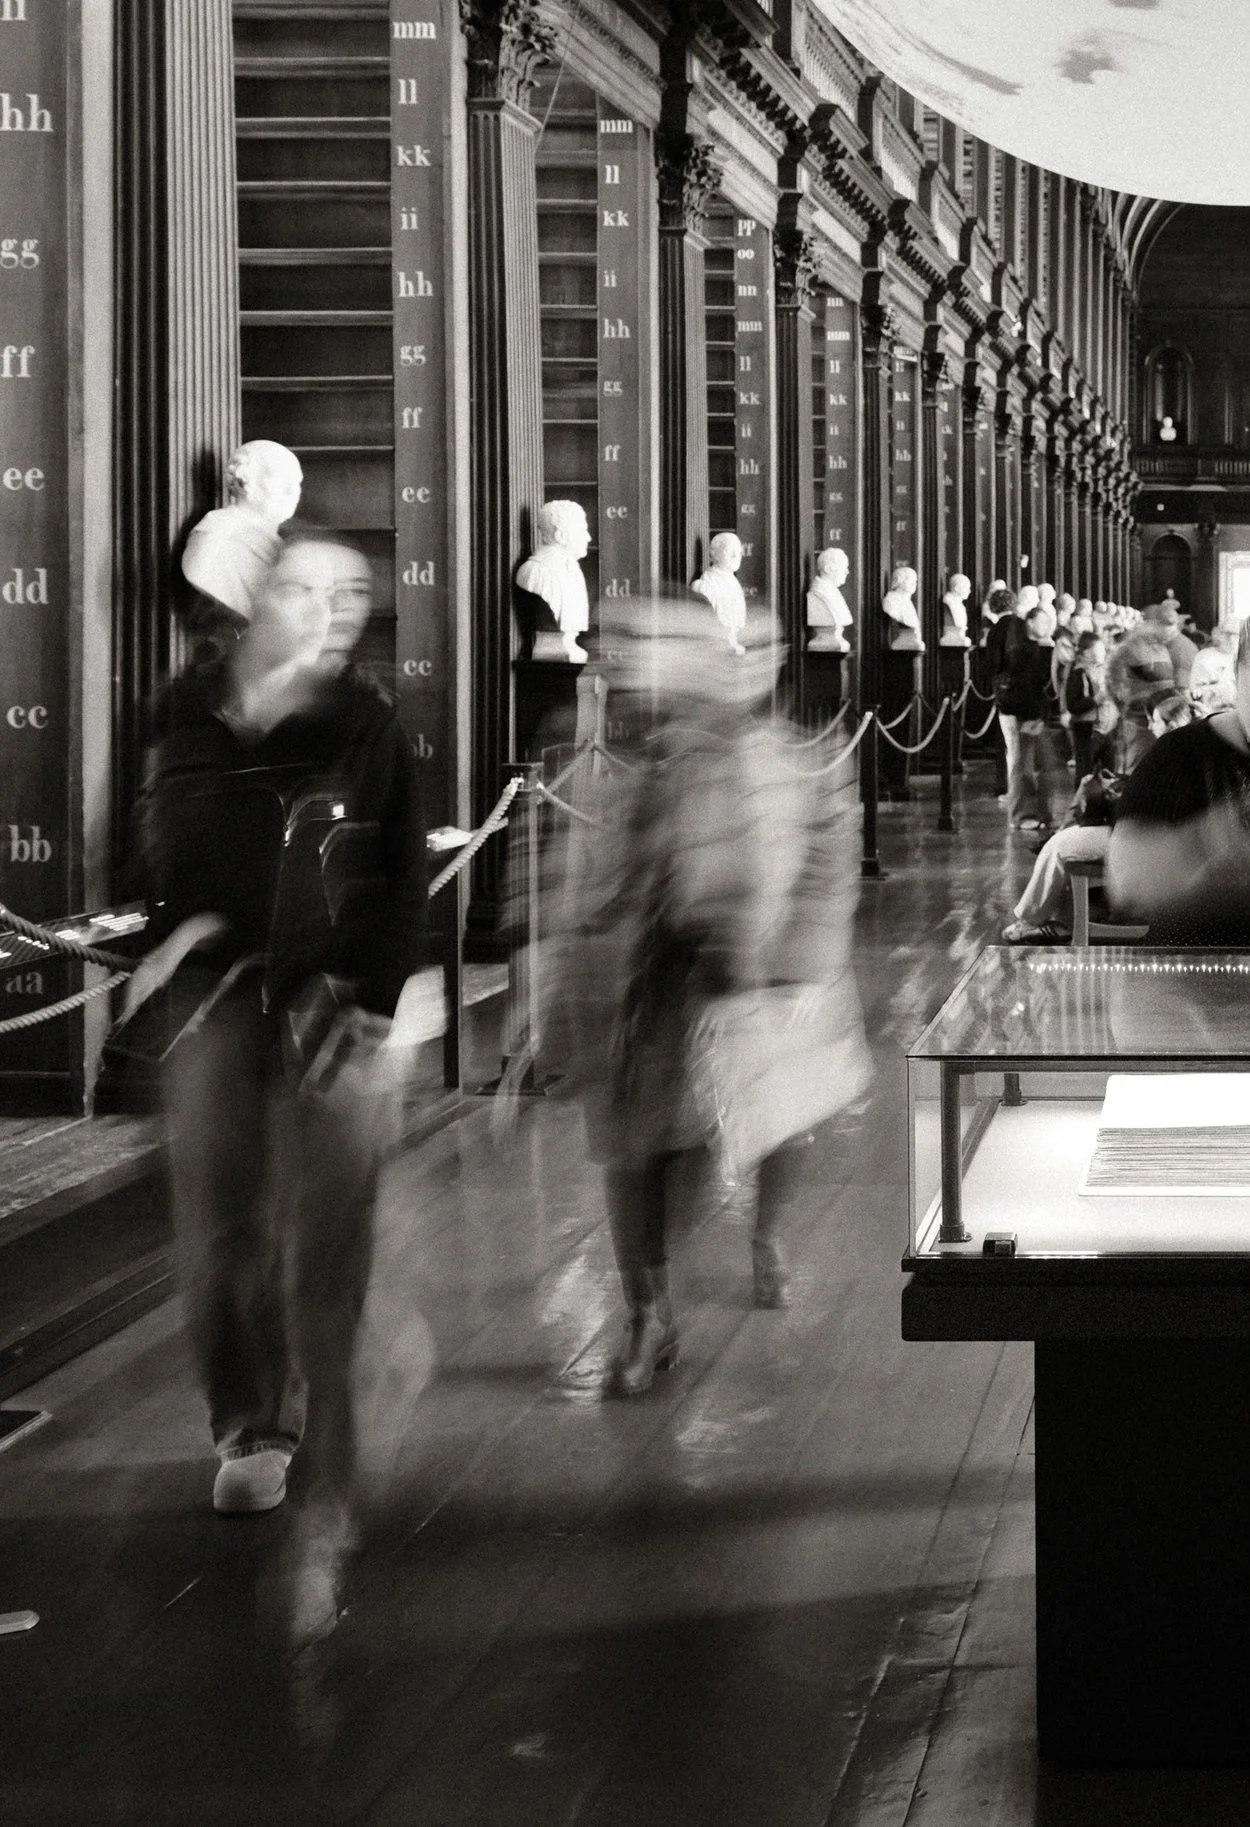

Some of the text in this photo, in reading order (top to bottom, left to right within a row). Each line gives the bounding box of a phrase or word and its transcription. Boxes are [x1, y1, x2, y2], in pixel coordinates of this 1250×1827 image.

[394, 22, 436, 39] mm
[399, 79, 417, 104] ll
[0, 93, 52, 131] hh
[600, 120, 632, 133] mm
[397, 145, 430, 165] kk
[606, 165, 619, 184] ll
[401, 208, 417, 229] ii
[604, 211, 628, 226] kk
[738, 220, 756, 236] pp
[0, 239, 39, 268] gg
[737, 249, 754, 259] oo
[398, 271, 432, 297] hh
[605, 271, 616, 287] ii
[738, 285, 756, 296] nn
[604, 318, 630, 338] hh
[738, 321, 762, 331] mm
[0, 346, 34, 378] ff
[400, 346, 425, 365] gg
[740, 356, 751, 371] ll
[604, 381, 622, 394] gg
[740, 392, 759, 404] kk
[830, 394, 846, 405] kk
[402, 407, 422, 428] ff
[605, 445, 620, 461] ff
[740, 459, 759, 474] hh
[829, 455, 846, 469] hh
[3, 468, 43, 490] ee
[402, 487, 429, 502] ee
[606, 507, 626, 519] ee
[403, 562, 433, 585] dd
[2, 568, 49, 604] dd
[606, 579, 632, 597] dd
[403, 660, 431, 675] cc
[7, 706, 49, 728] cc
[9, 825, 51, 861] bb
[6, 972, 42, 993] aa
